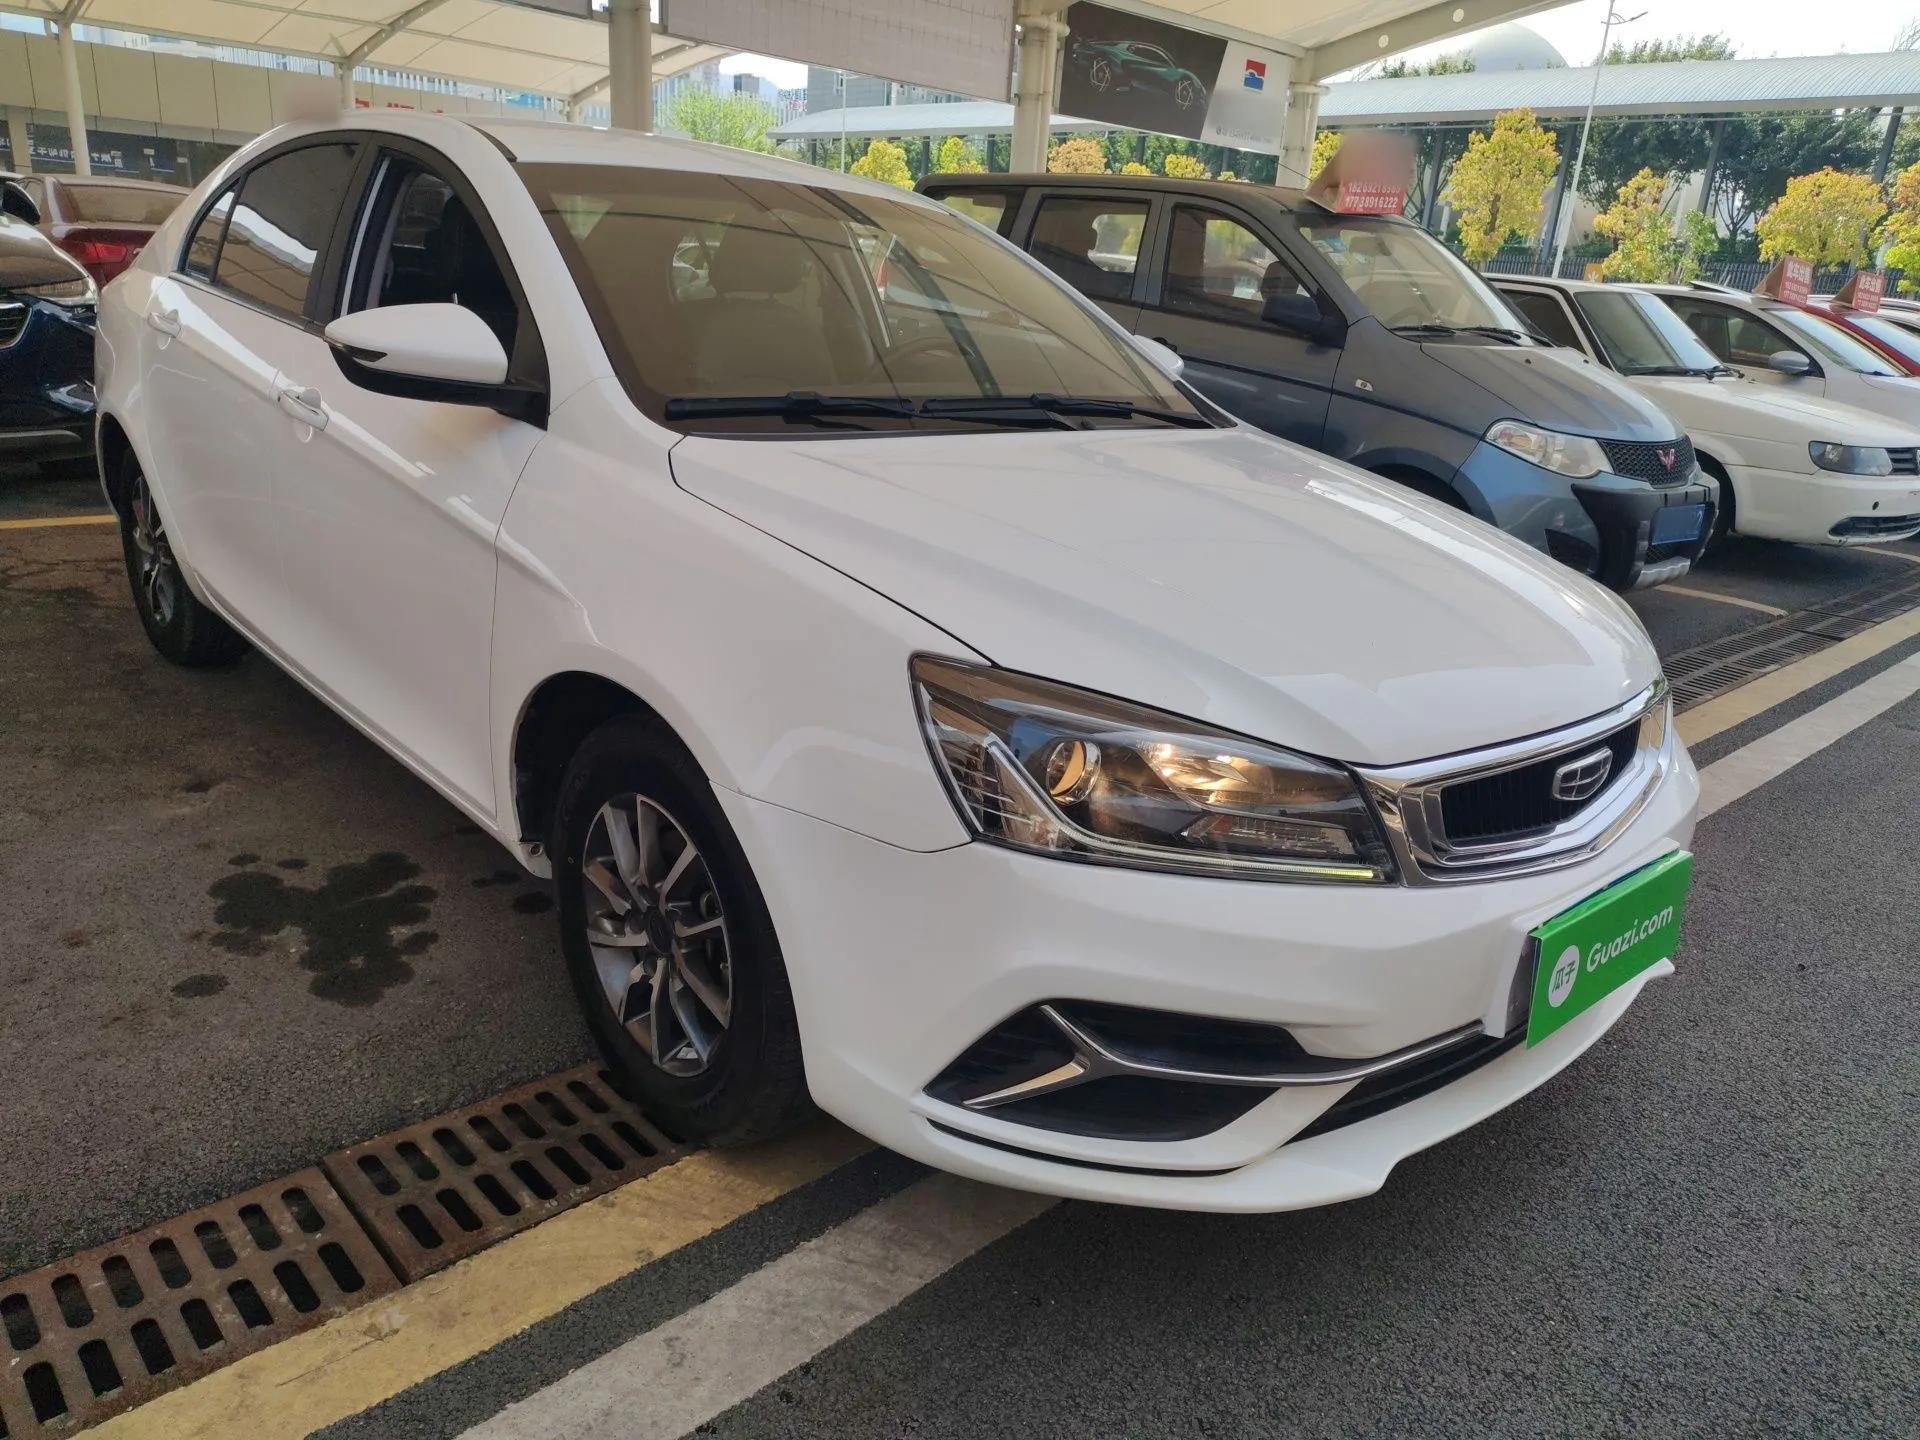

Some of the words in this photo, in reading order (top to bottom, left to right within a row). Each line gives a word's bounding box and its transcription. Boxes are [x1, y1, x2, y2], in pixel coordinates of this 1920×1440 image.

[1345, 196, 1399, 208] 17738916222
[1586, 905, 1674, 973] Guazi.com
[1551, 960, 1576, 993] 瓜子
